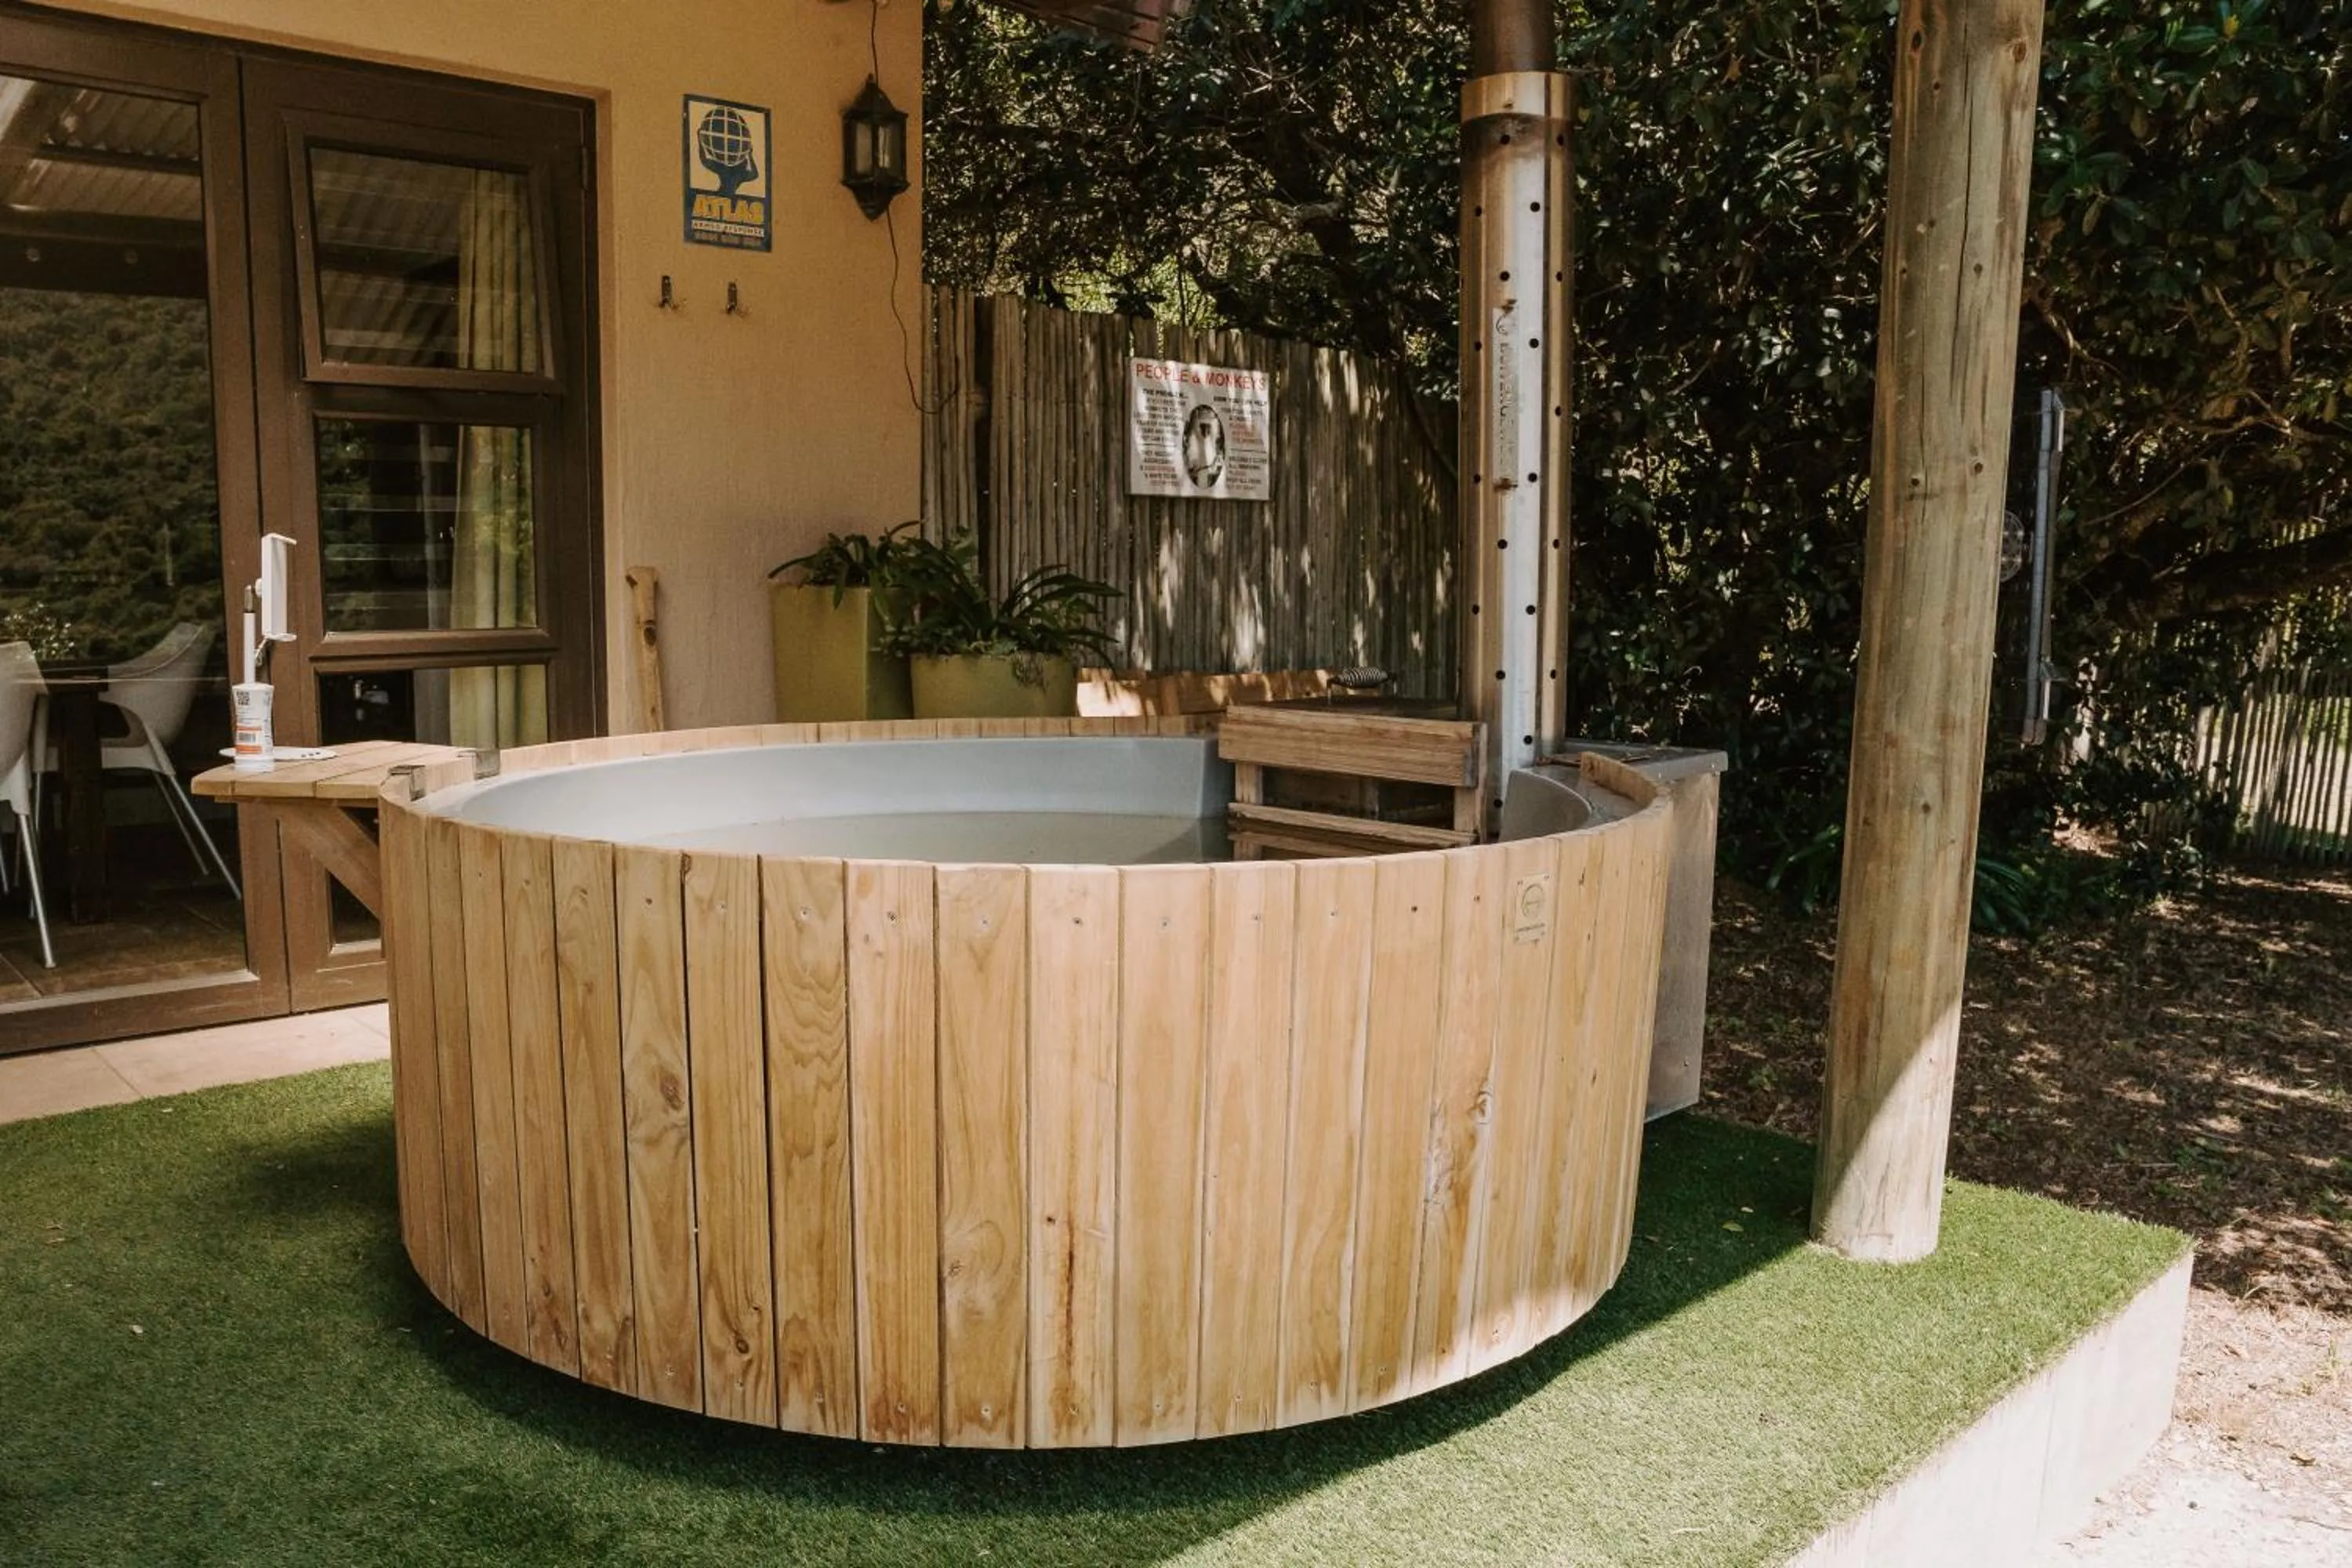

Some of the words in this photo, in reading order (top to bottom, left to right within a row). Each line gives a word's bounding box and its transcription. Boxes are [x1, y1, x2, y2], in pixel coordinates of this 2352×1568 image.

[692, 194, 764, 224] ATLAS
[1136, 363, 1188, 383] PEOPLE
[1192, 373, 1200, 384] &
[1206, 371, 1265, 390] MONKEYS
